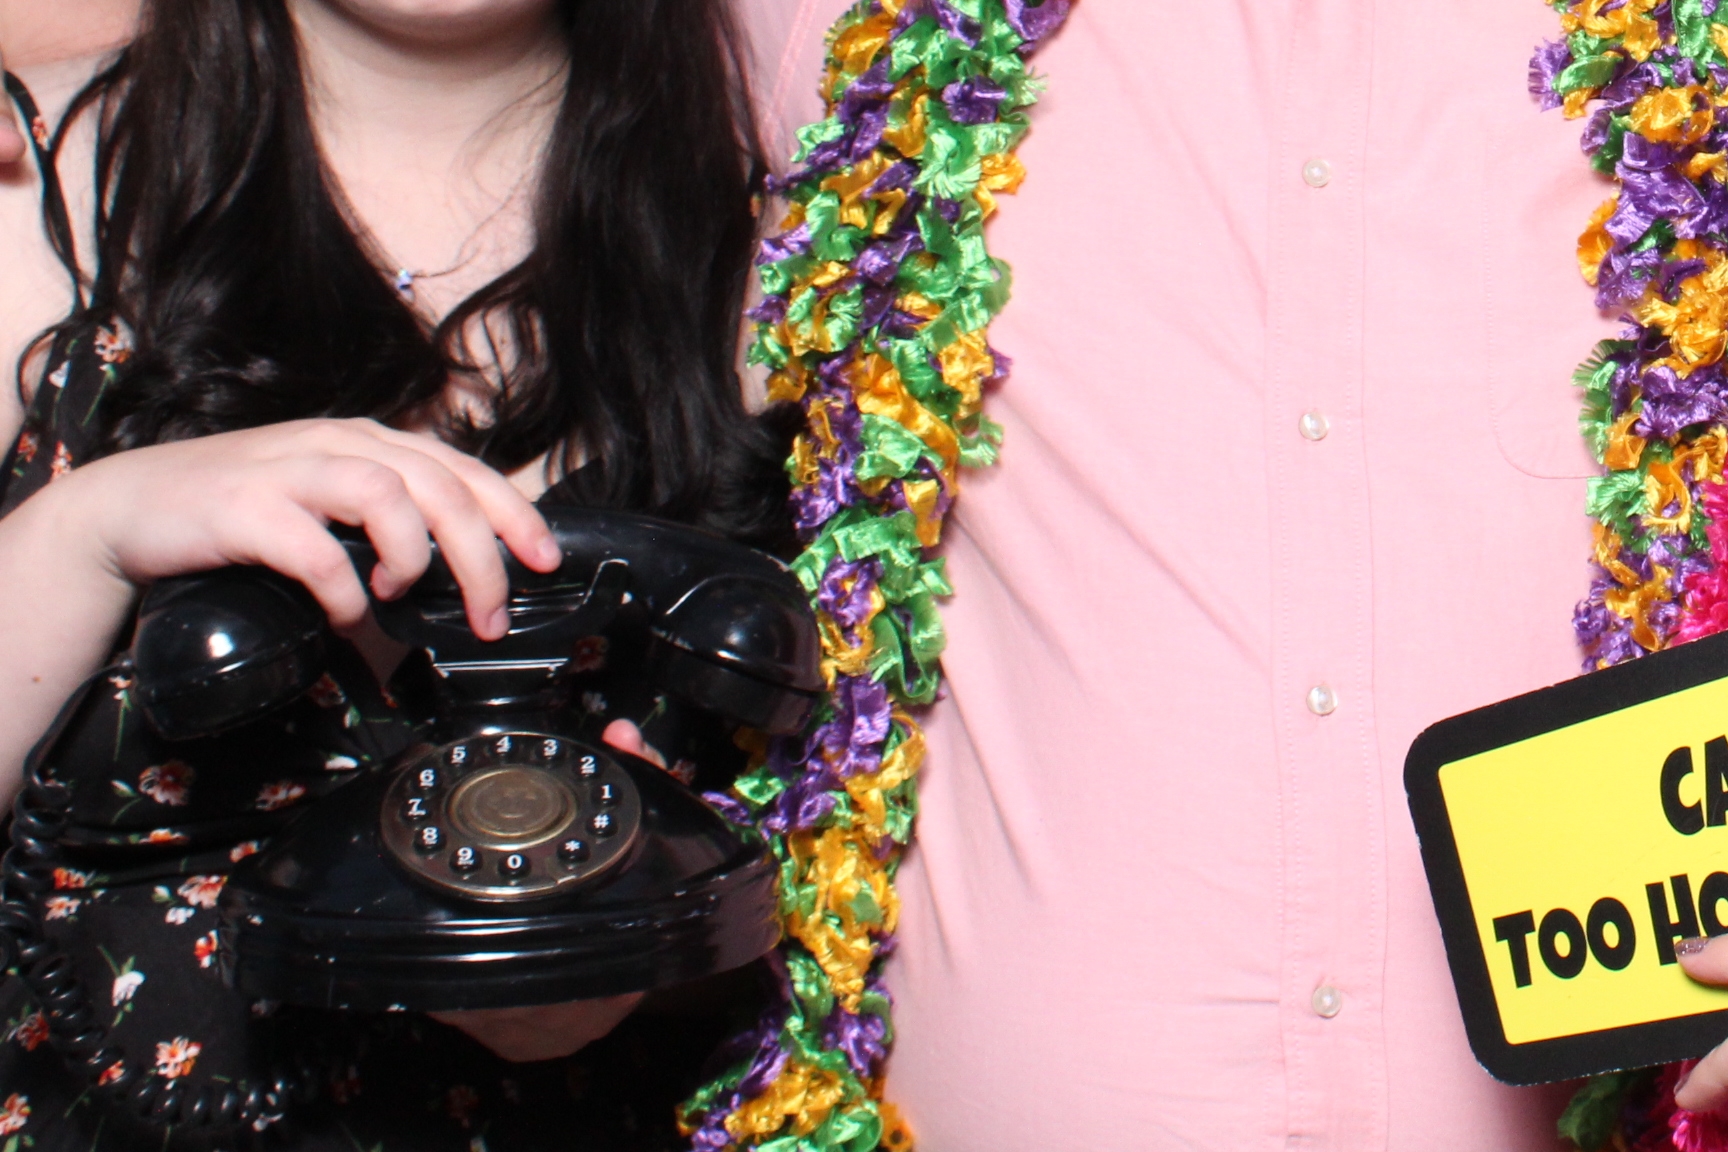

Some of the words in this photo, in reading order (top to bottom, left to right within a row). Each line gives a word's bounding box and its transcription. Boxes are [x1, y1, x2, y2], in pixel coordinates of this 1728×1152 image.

[496, 735, 511, 750] 4
[543, 739, 557, 753] 3
[452, 746, 466, 760] 5
[581, 756, 595, 769] 2
[419, 769, 434, 782] 6
[601, 784, 612, 799] 1
[422, 826, 437, 841] 8
[458, 847, 473, 861] 9
[506, 854, 522, 869] 0
[1493, 898, 1635, 988] TOO
